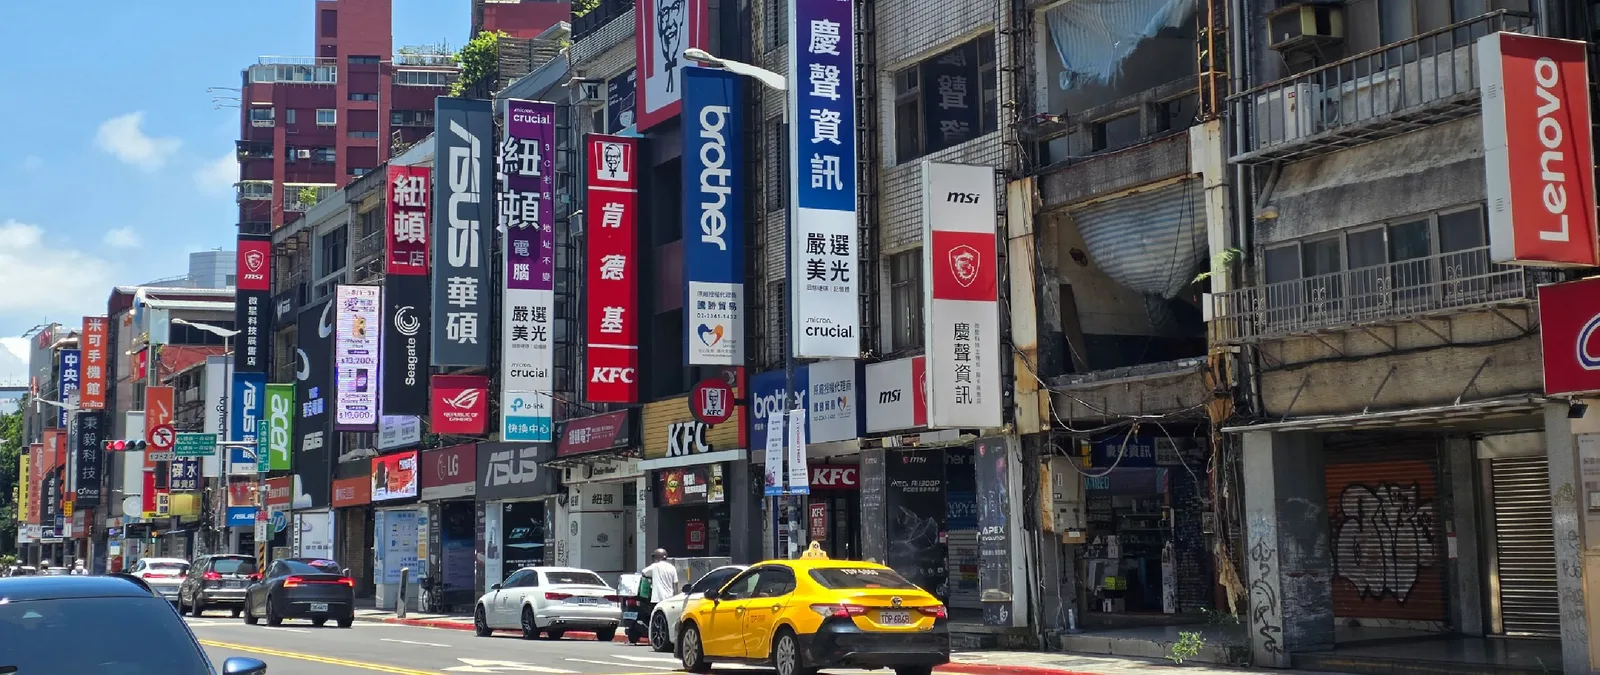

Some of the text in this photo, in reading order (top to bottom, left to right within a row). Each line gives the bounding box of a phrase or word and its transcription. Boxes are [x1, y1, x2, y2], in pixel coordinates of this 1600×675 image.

[808, 19, 843, 190] 慶聲資訊
[1534, 56, 1570, 243] Lenovo
[700, 105, 732, 250] brother
[448, 119, 480, 267] ASUS
[947, 191, 980, 204] msi
[393, 174, 426, 244] 紐頓
[806, 232, 850, 256] 嚴選
[392, 250, 425, 266] 二店
[600, 202, 626, 333] 肯德基
[806, 259, 850, 282] 美光
[446, 277, 479, 344] 華碩
[512, 306, 547, 323] 嚴選
[512, 325, 547, 341] 美光
[86, 319, 102, 396] 米可手機館
[405, 338, 418, 386] Seagate
[953, 322, 973, 404] 慶聲資訊
[591, 367, 635, 383] KFC
[243, 380, 256, 432] ASUS
[879, 388, 901, 404] msi
[271, 393, 289, 461] acer
[508, 423, 550, 434] 快換中心
[666, 421, 710, 458] KFC
[447, 454, 459, 476] LG
[484, 446, 538, 487] ASUS
[811, 468, 856, 485] KFC
[592, 493, 614, 505] 紐頓
[232, 512, 256, 520] ASUS
[811, 507, 824, 517] KFC
[982, 526, 1004, 534] APEX
